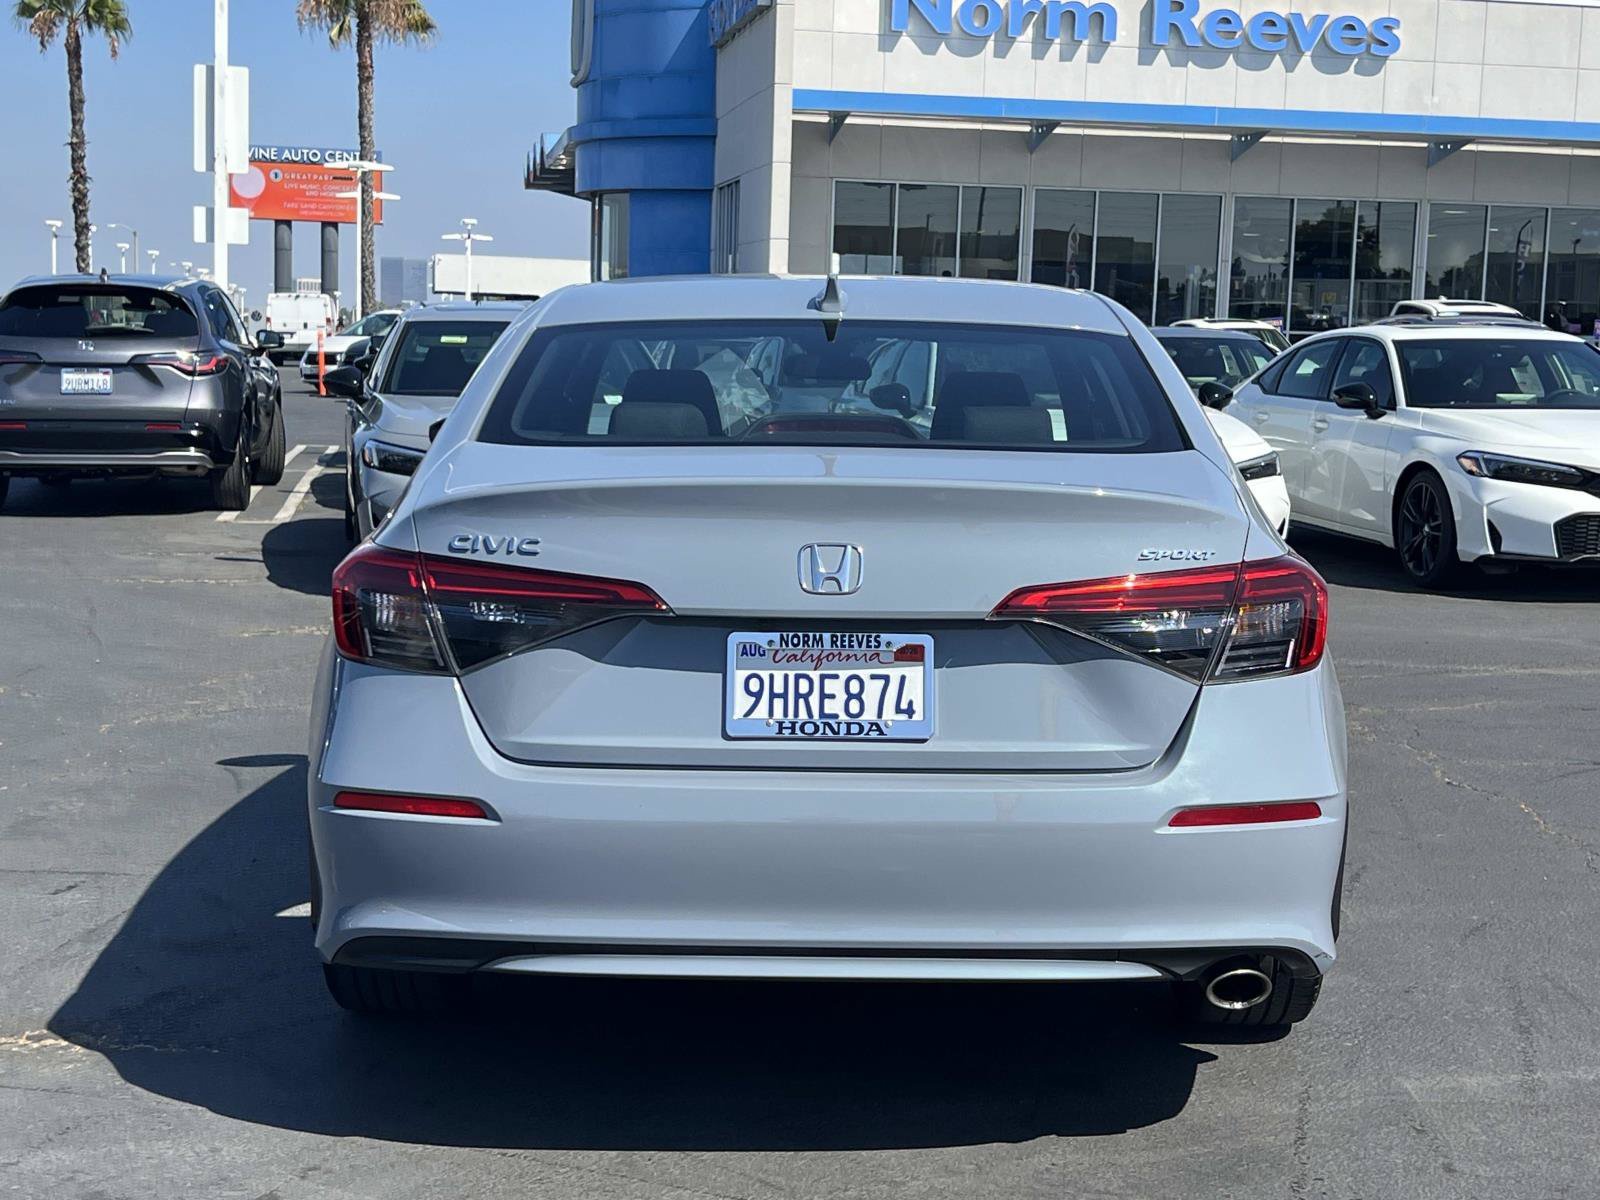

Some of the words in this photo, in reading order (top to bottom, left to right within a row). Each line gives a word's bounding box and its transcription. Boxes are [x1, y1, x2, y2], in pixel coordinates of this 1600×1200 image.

[889, 0, 1118, 42] Norm
[1150, 0, 1401, 57] Reeves
[248, 147, 278, 160] VINE
[281, 149, 321, 162] AUTO
[324, 150, 376, 163] CENT
[447, 534, 542, 557] CIVIC
[1137, 548, 1217, 561] SPORT
[779, 633, 824, 649] NORM
[829, 633, 882, 650] REEVES
[740, 643, 767, 658] AUG
[772, 648, 895, 671] California
[742, 672, 916, 720] 9HRE874
[774, 720, 888, 737] HONDA
